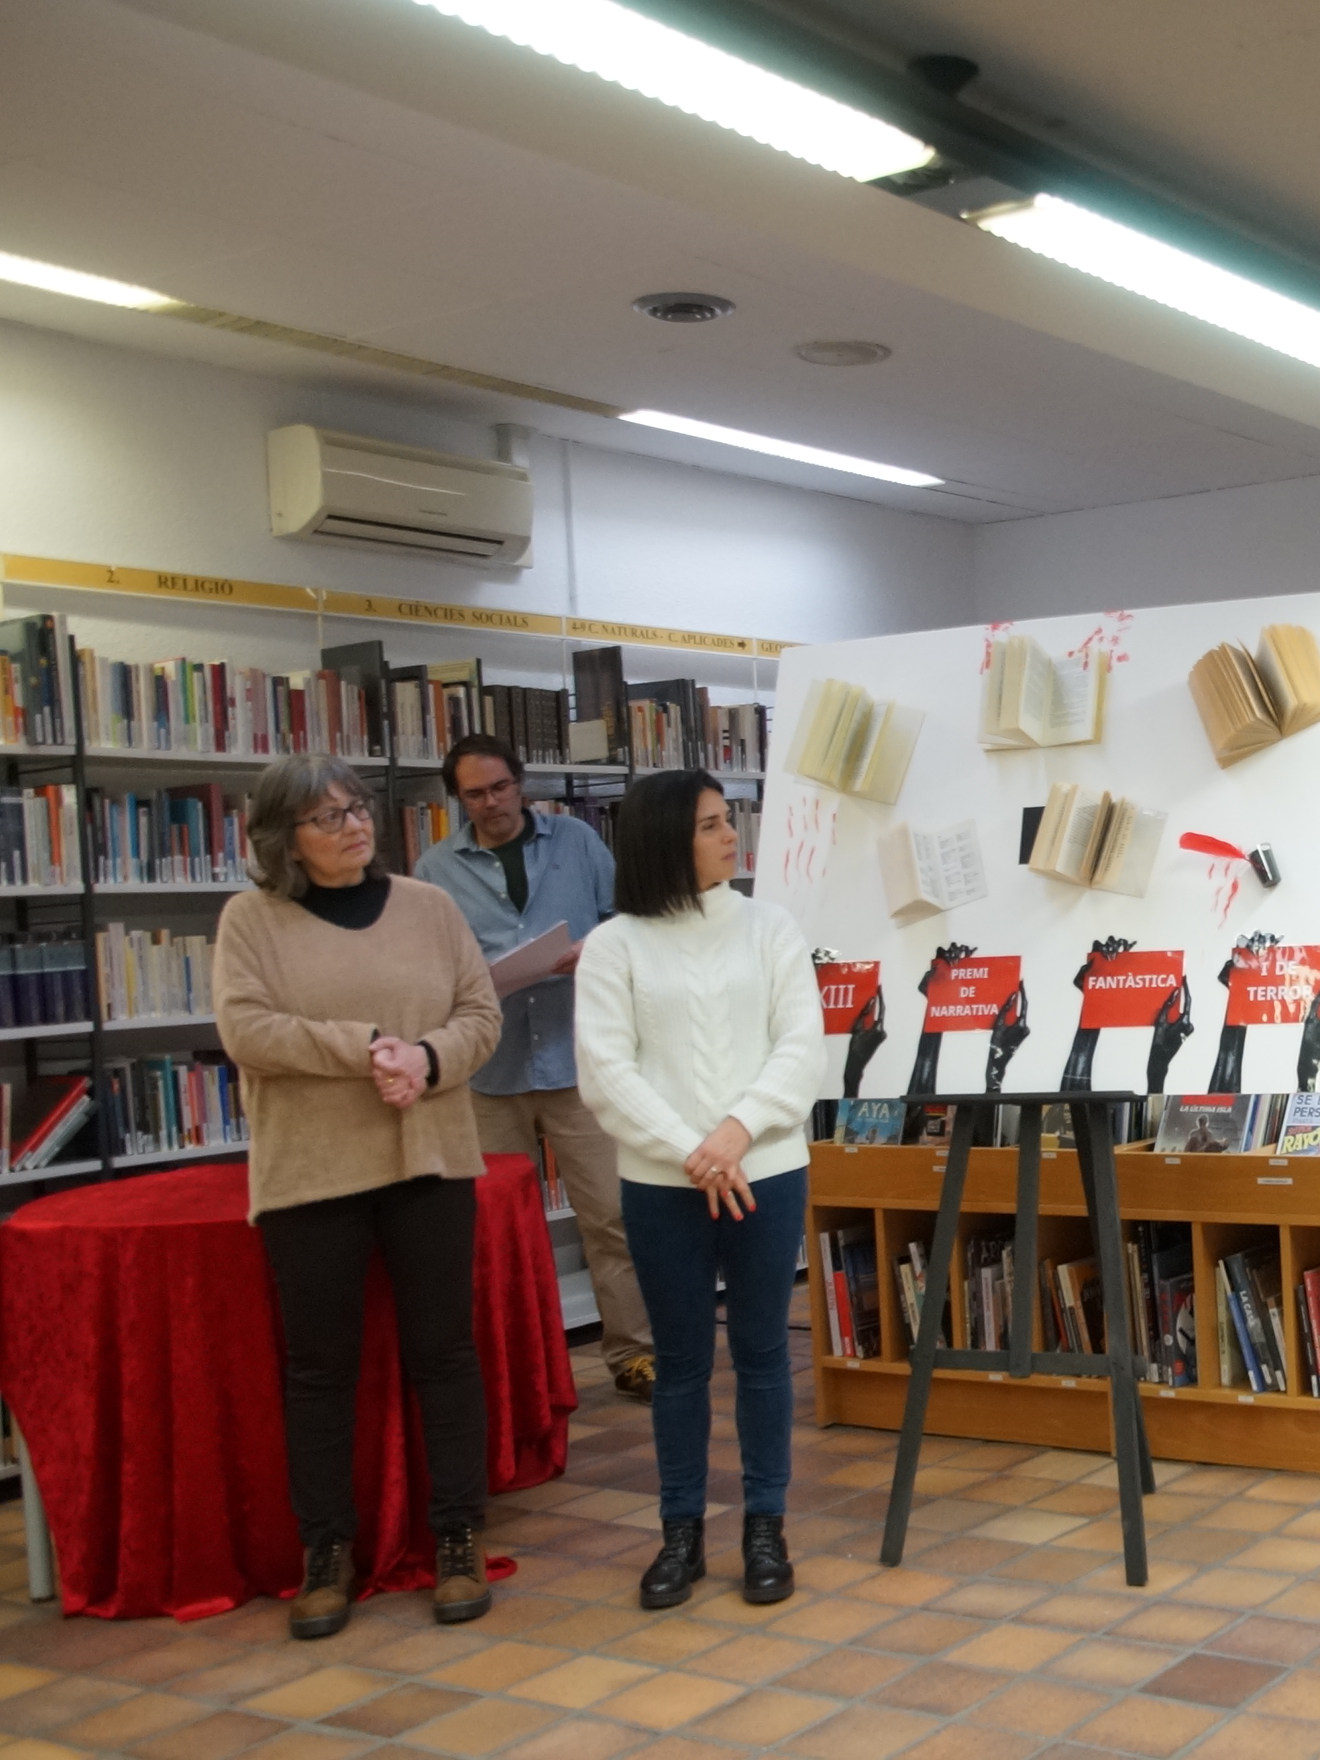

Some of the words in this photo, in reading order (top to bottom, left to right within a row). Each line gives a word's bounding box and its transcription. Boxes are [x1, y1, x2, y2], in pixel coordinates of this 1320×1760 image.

[106, 569, 121, 584] 2.
[157, 574, 233, 596] RELIGIÓ
[364, 599, 376, 613] 3.
[398, 601, 466, 622] CIÈNCIES
[471, 610, 529, 628] SOCIALS
[602, 624, 657, 639] NATURALS
[681, 635, 735, 648] APLICADES
[951, 967, 989, 980] PREMI
[1275, 960, 1297, 976] DE
[1087, 971, 1177, 990] FANTÀSTICA
[959, 986, 976, 998] DE
[1247, 985, 1315, 1001] TERROR
[930, 1003, 999, 1017] NARRATIVA
[1296, 1094, 1312, 1106] SE
[858, 1101, 890, 1119] AYA
[1179, 1105, 1189, 1113] LA
